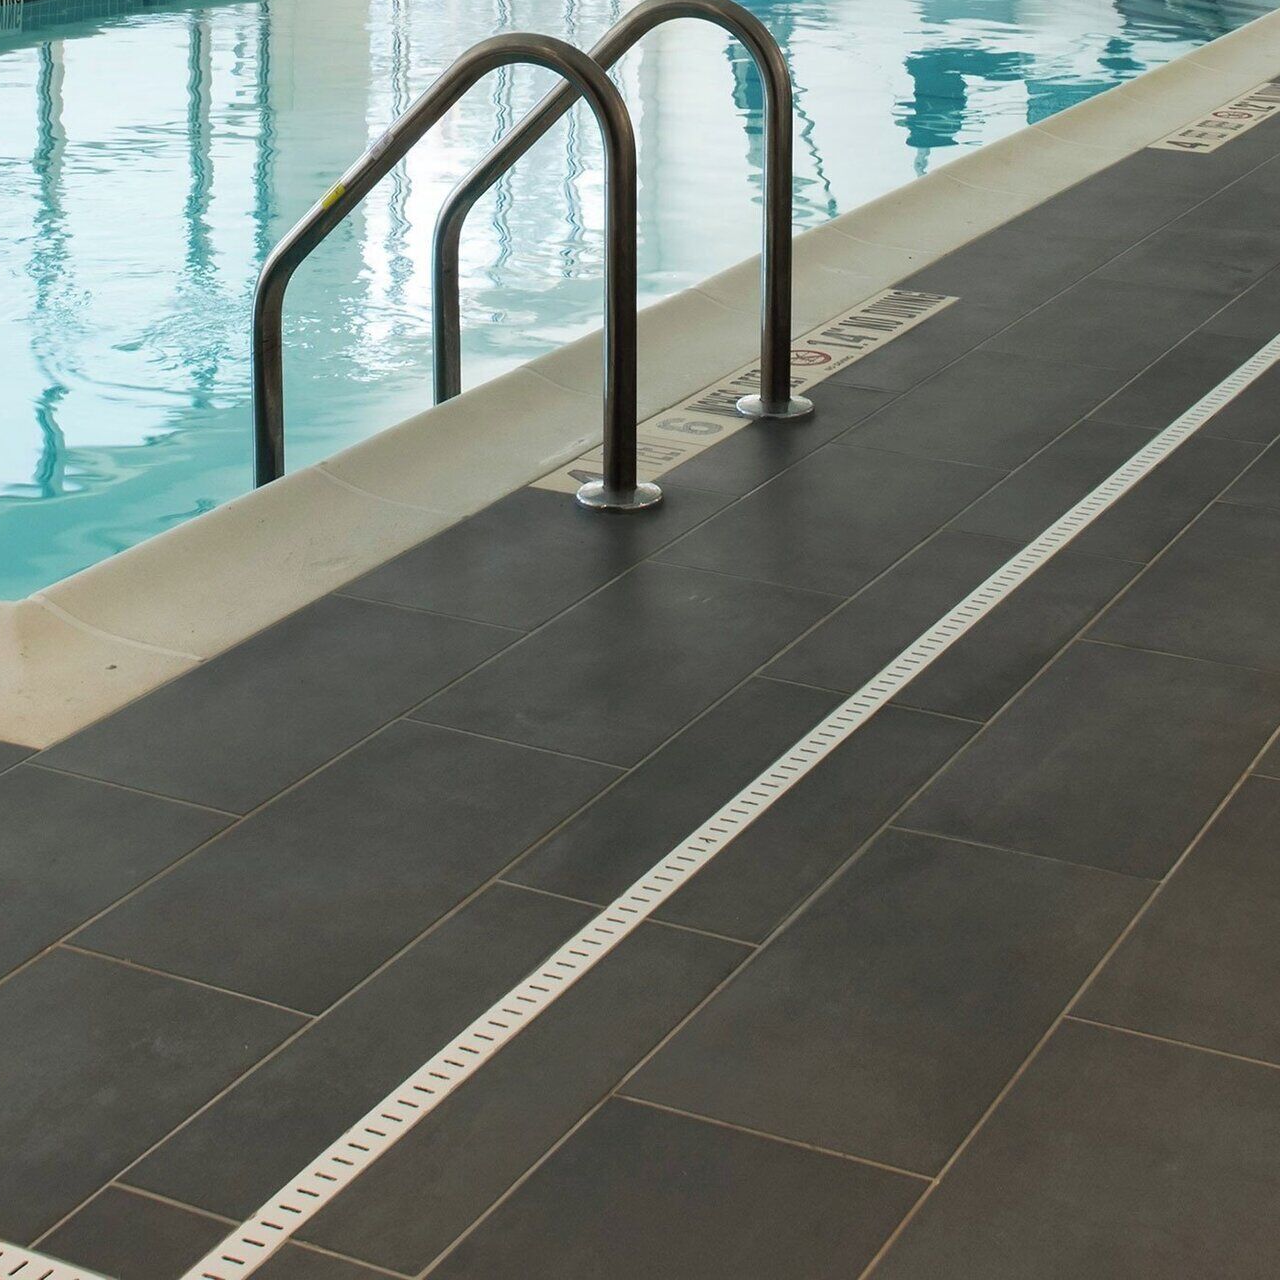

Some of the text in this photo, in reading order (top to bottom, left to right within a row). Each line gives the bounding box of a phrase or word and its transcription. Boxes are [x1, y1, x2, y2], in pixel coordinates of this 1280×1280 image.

[861, 291, 946, 319] DIVING
[838, 316, 904, 332] NO
[655, 417, 724, 436] 6
